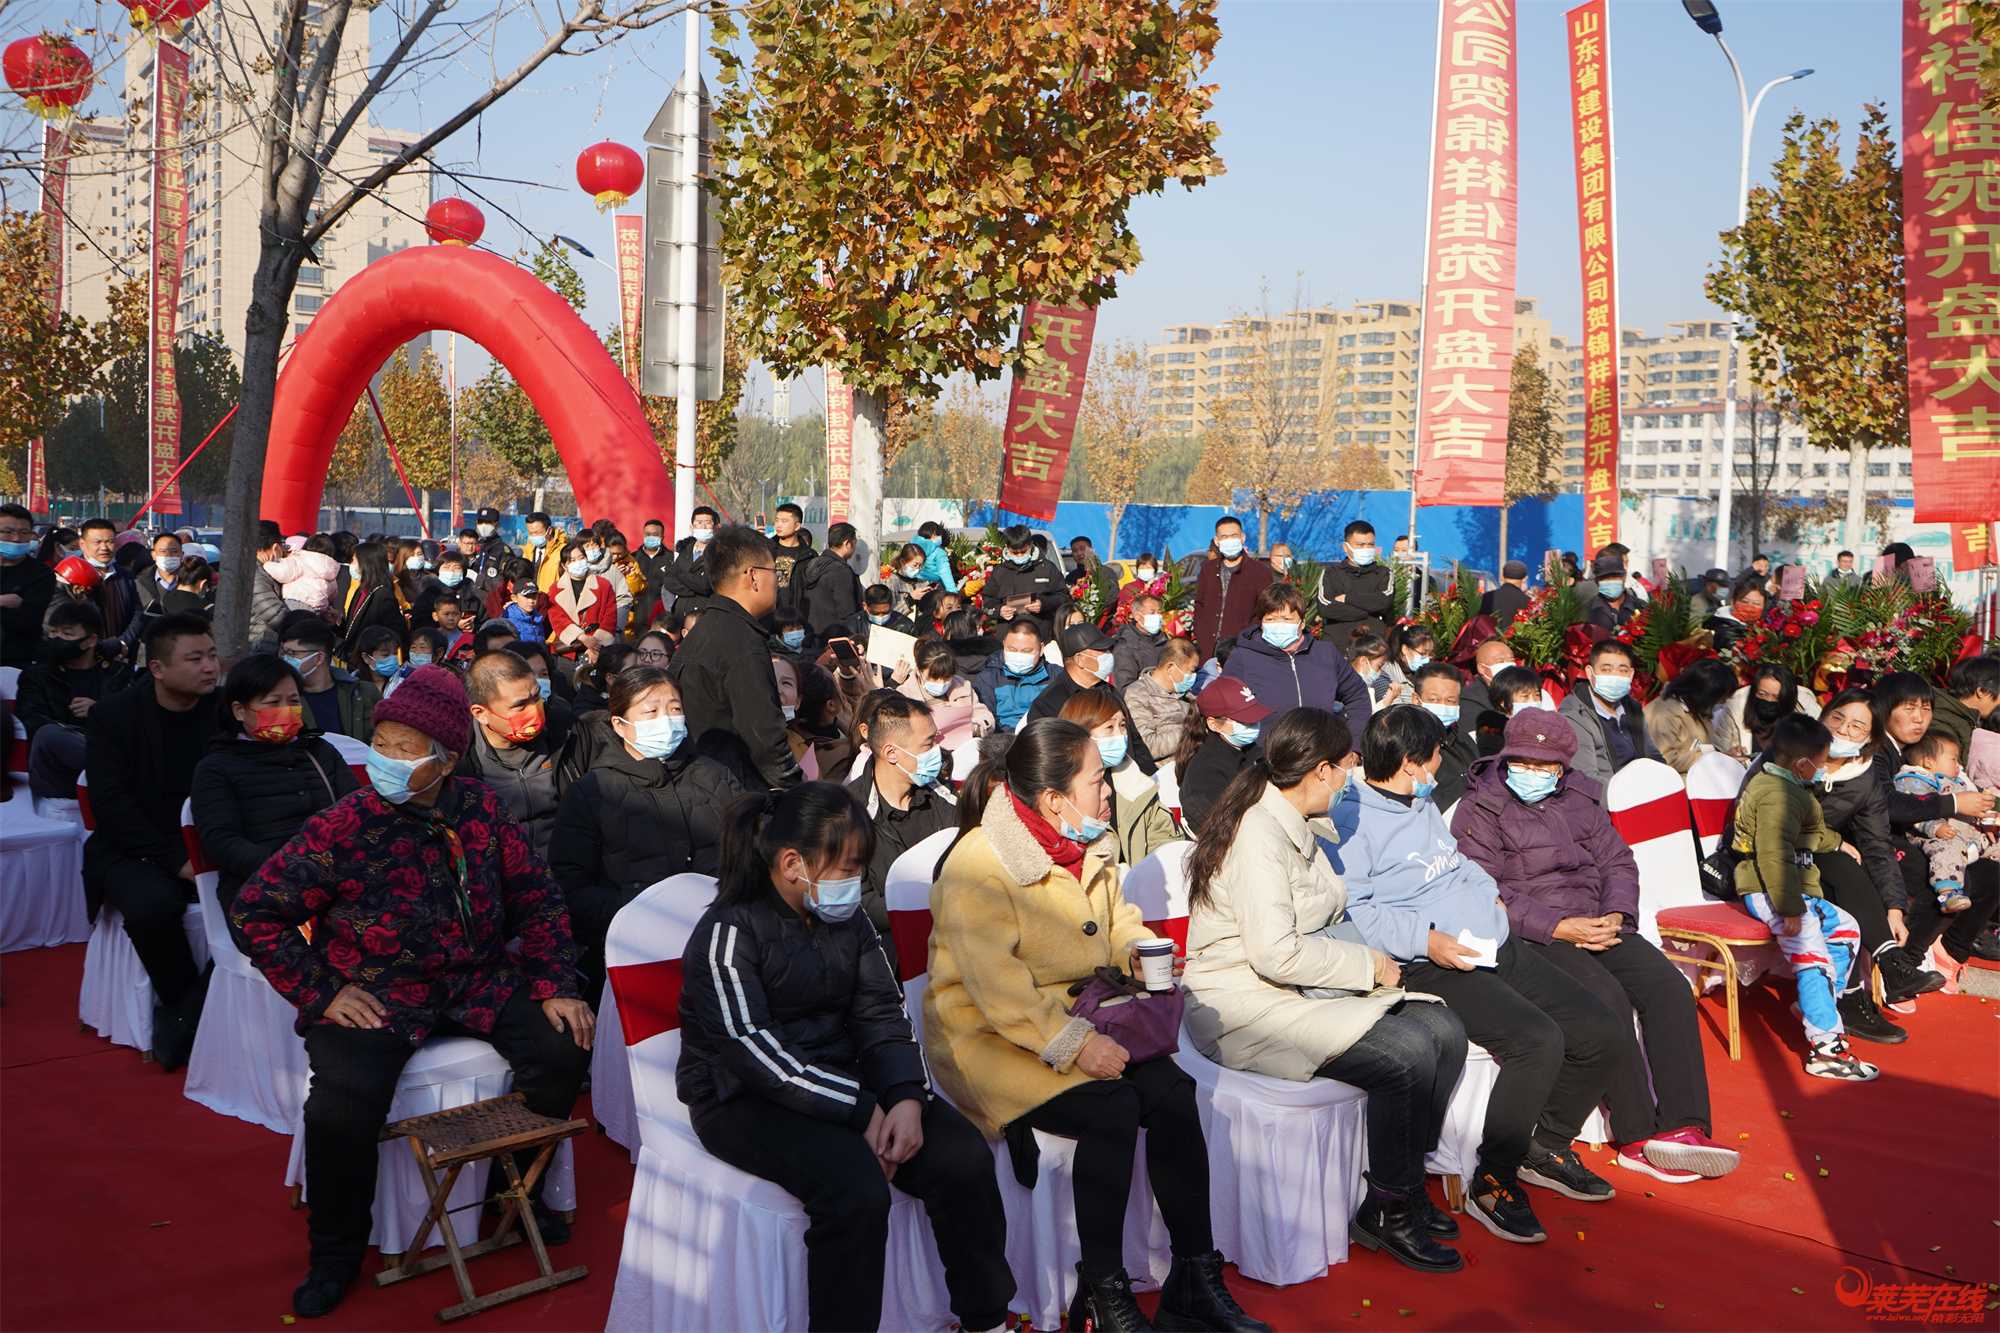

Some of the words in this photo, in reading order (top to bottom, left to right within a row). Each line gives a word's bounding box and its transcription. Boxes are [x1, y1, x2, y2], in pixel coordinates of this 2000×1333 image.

[1574, 11, 1613, 548] 山东省建设集团有限公司贺锦祥佳苑开盘大吉
